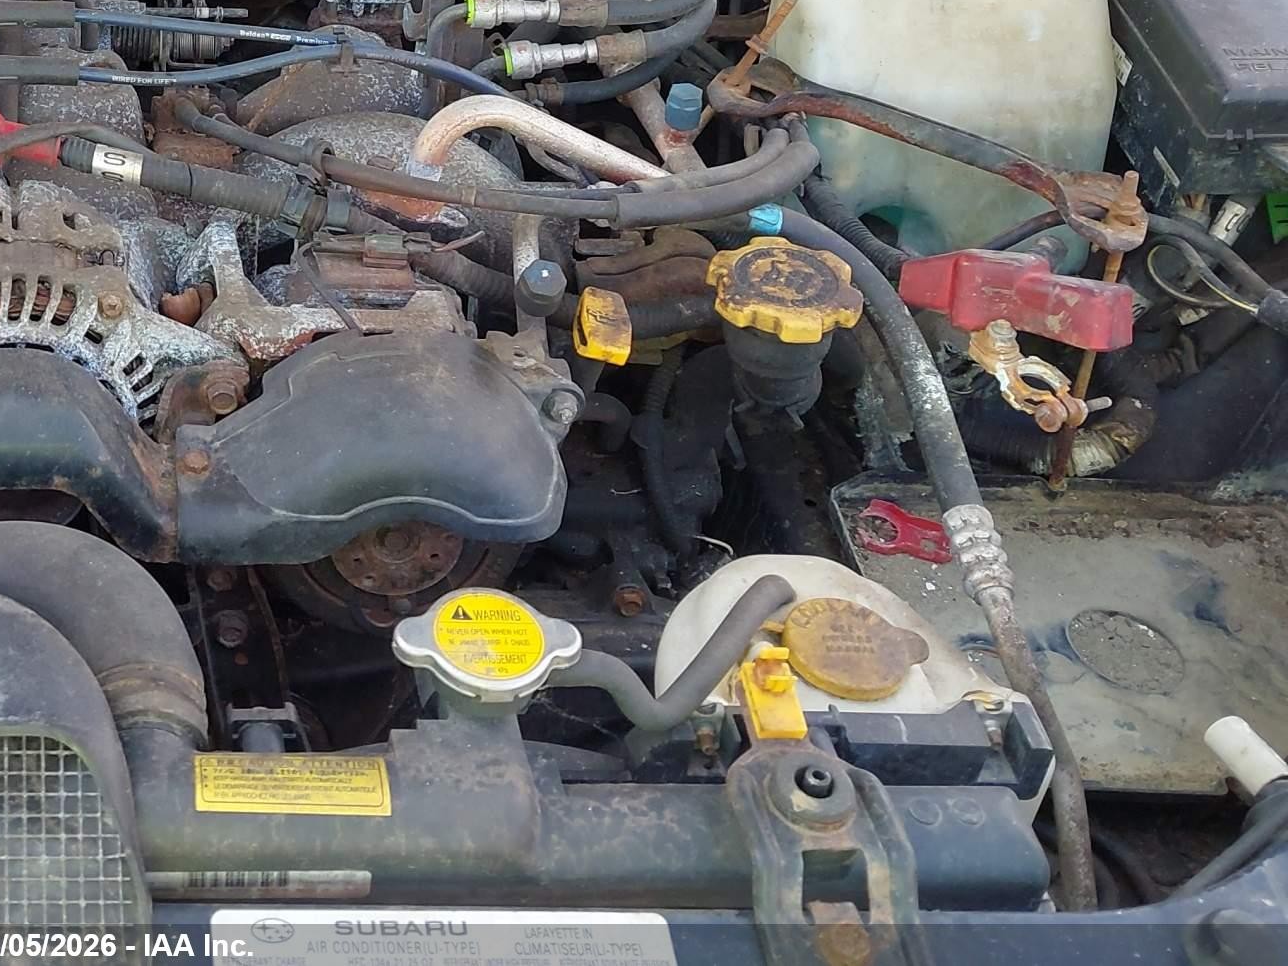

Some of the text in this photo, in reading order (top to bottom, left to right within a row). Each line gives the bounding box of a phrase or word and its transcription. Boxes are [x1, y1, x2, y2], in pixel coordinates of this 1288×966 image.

[111, 75, 136, 83] WIRED
[473, 609, 520, 622] WARNING
[334, 920, 468, 936] SUBARU
[525, 927, 581, 939] LAFAYETTE
[307, 941, 327, 955] AIR
